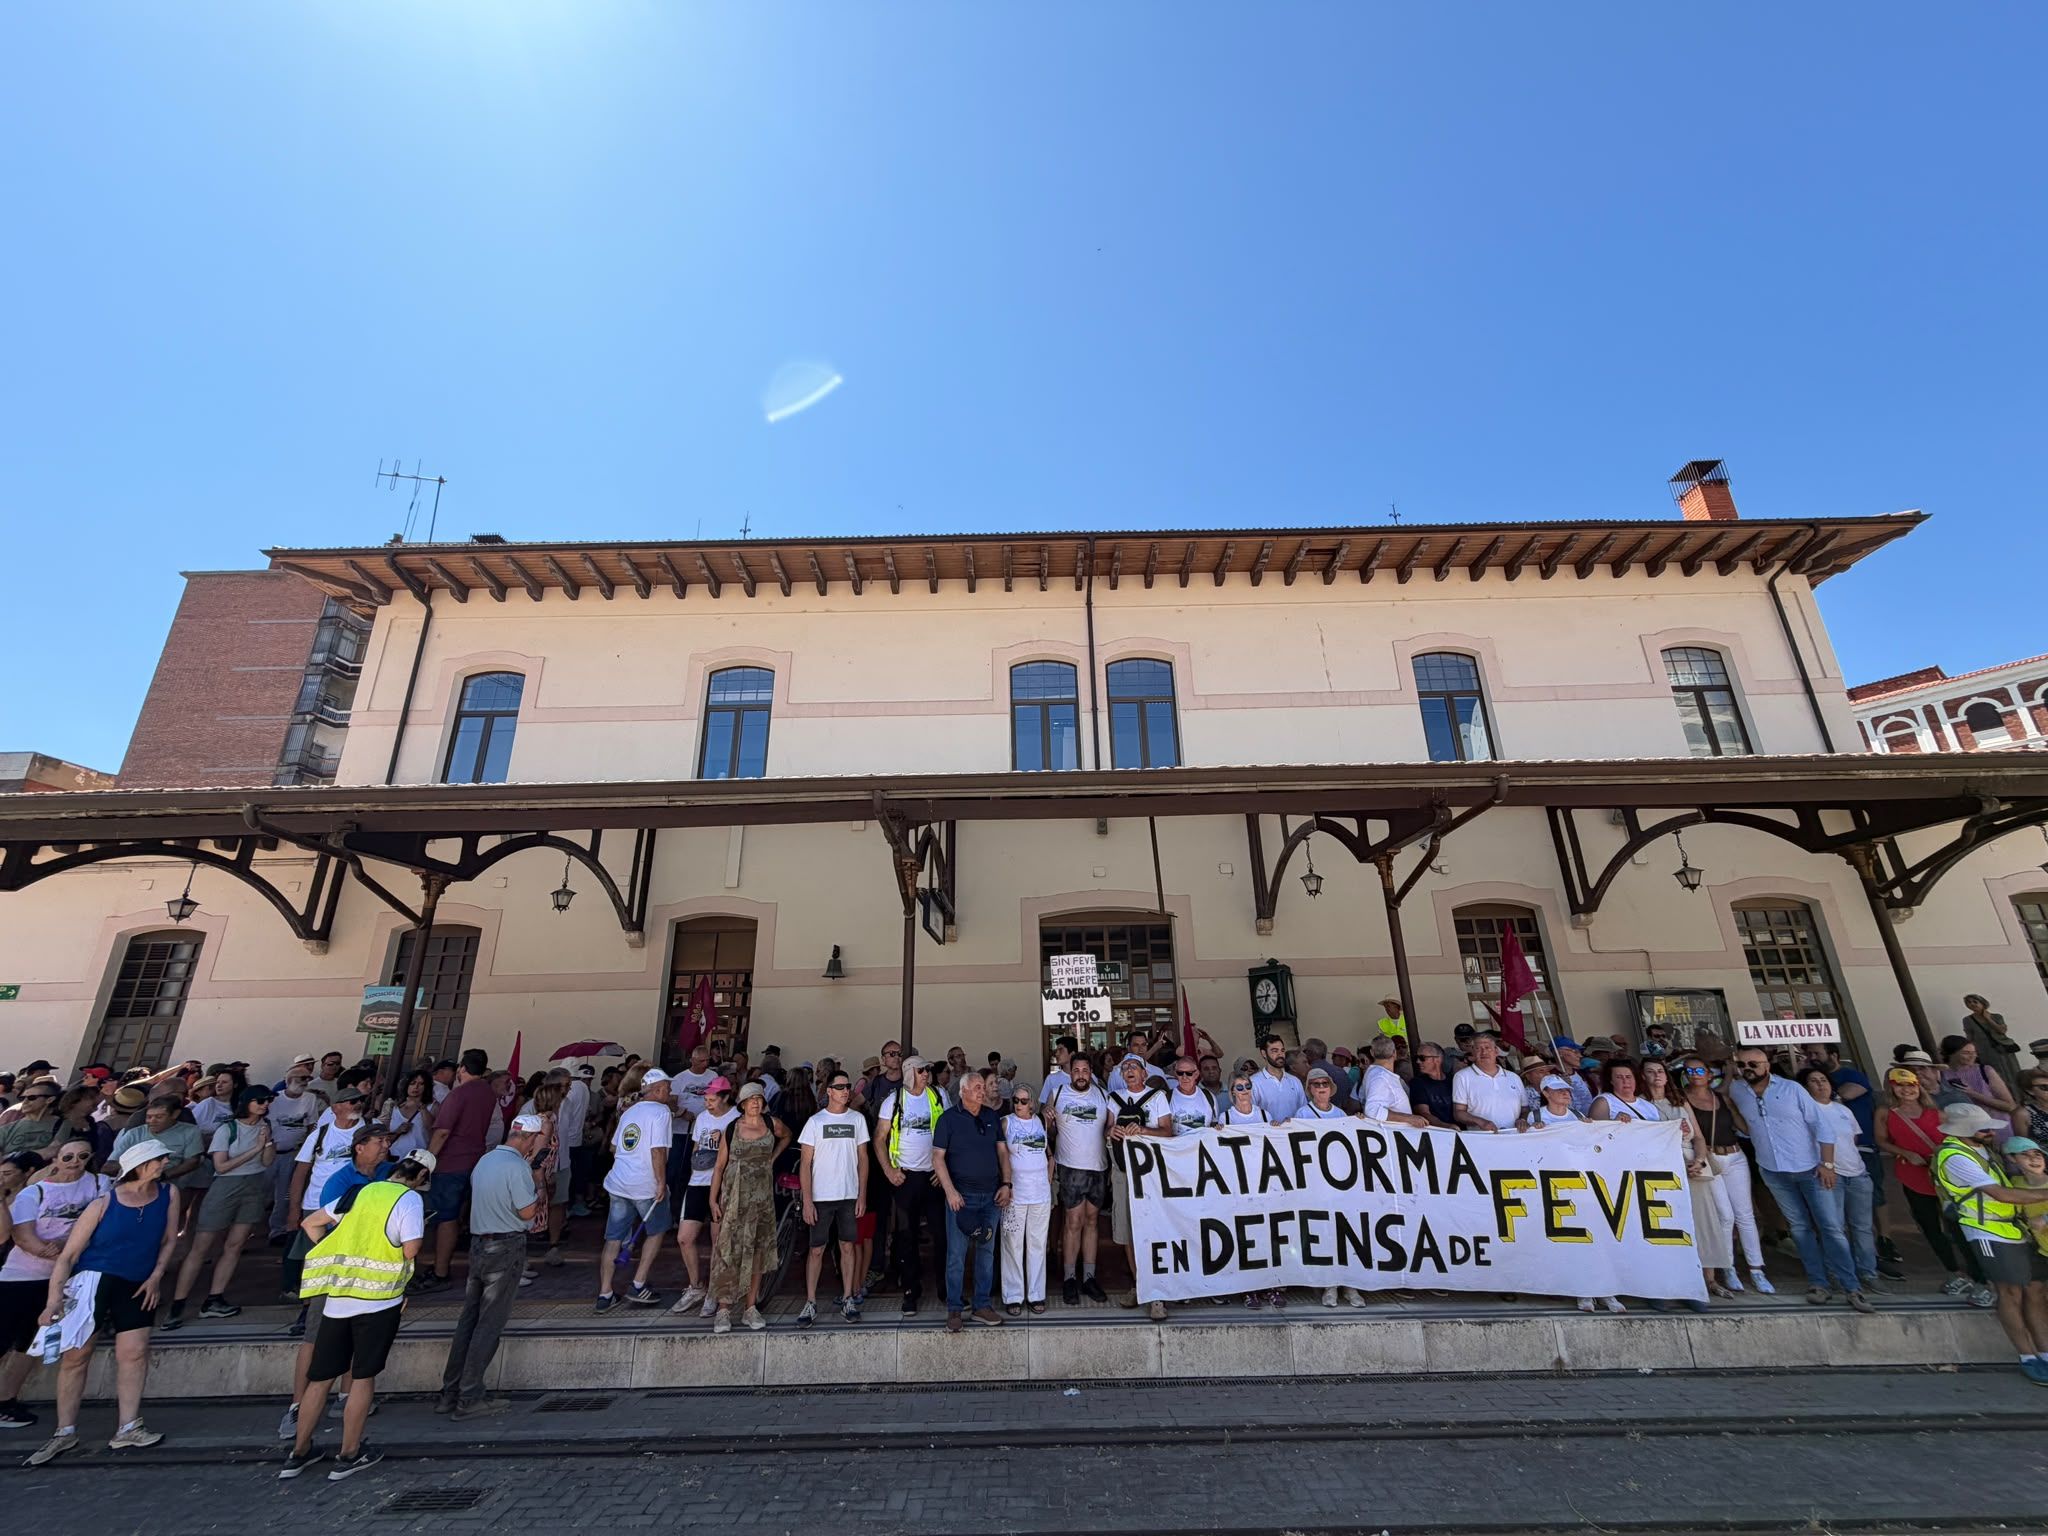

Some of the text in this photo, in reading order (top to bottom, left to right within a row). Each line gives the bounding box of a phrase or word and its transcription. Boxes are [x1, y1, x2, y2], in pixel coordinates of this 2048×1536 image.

[1051, 956, 1096, 967] SIN FEVE
[1052, 968, 1064, 977] LA
[1052, 975, 1098, 987] SE MUERE
[1042, 987, 1110, 1000] VALDERILLA
[1072, 999, 1086, 1011] DE
[1058, 1010, 1100, 1023] TORIO
[1744, 1023, 1832, 1039] LA VALCUEVA
[1126, 1129, 1490, 1199] PLATAFORMA
[1151, 1170, 1693, 1276] EN DEFENSA DE FEVE
